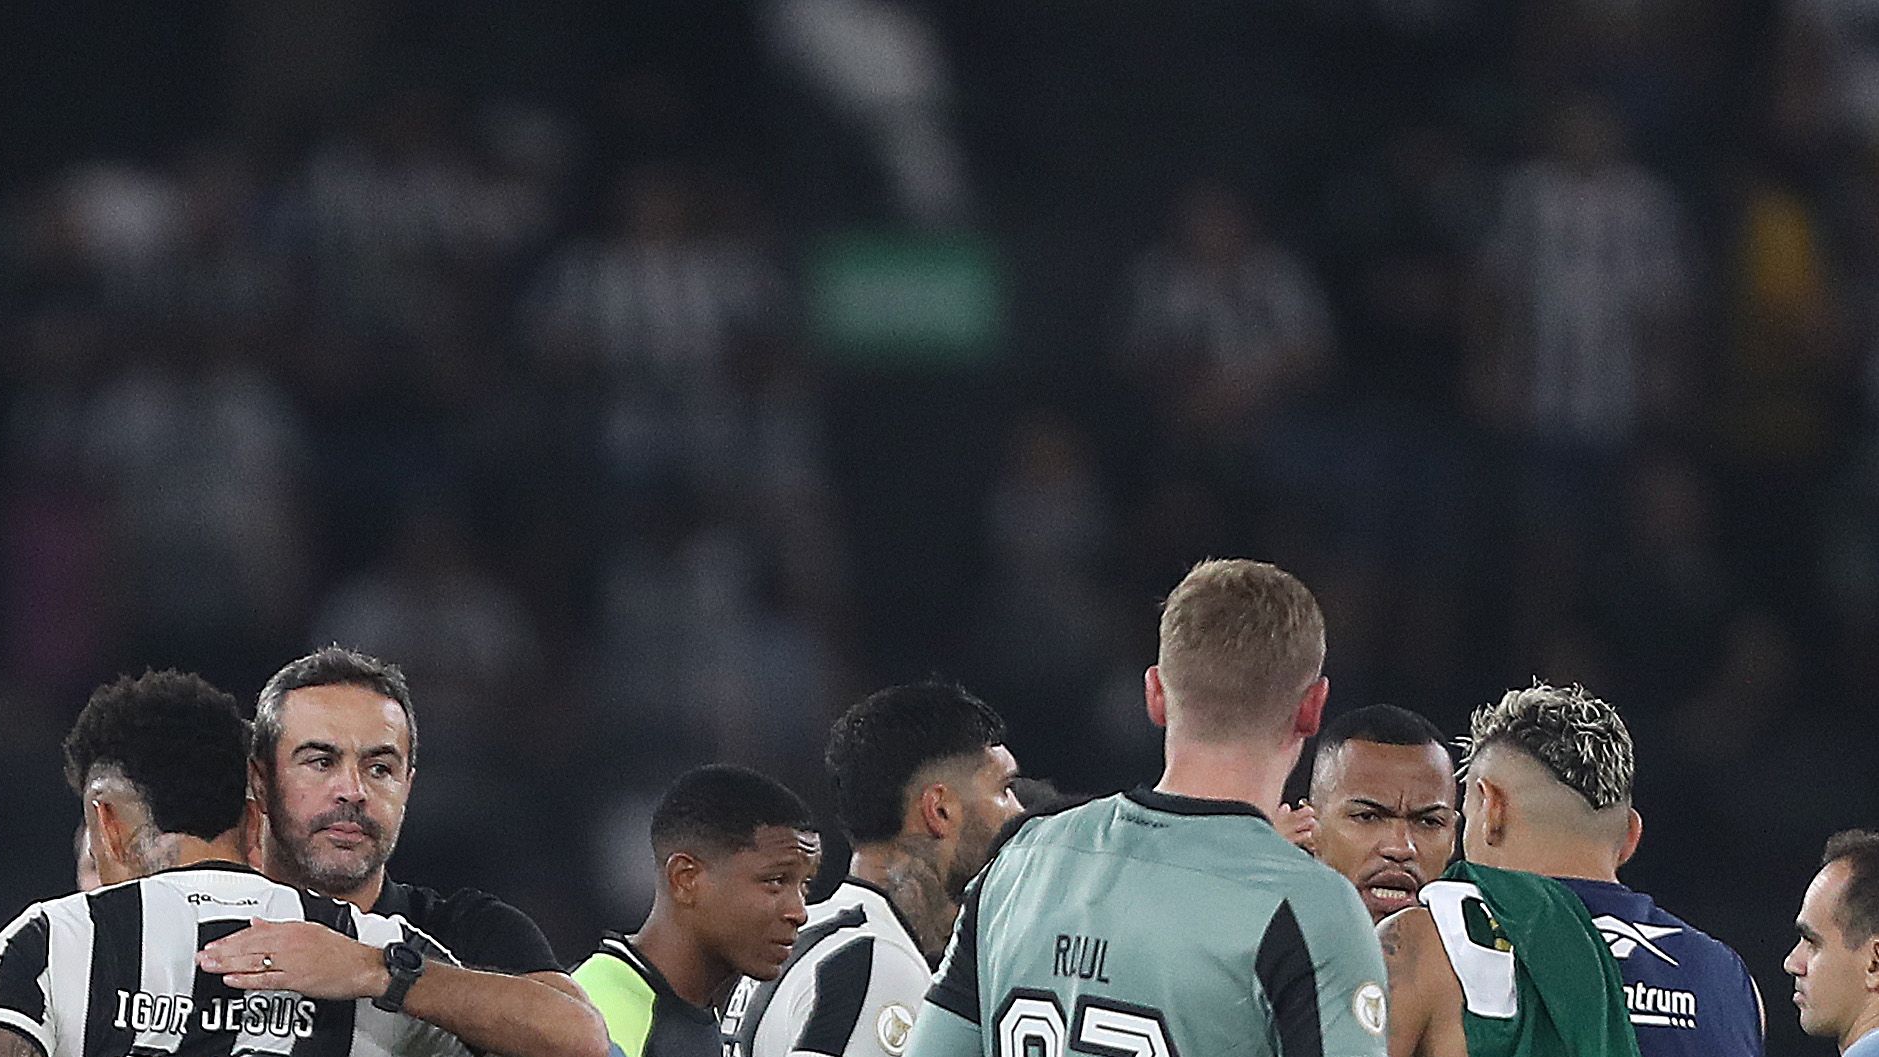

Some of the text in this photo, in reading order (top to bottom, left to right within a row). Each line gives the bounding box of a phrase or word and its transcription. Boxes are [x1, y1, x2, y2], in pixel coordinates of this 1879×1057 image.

[114, 989, 316, 1038] IGOR JESUS
[1623, 982, 1696, 1016] ntrum
